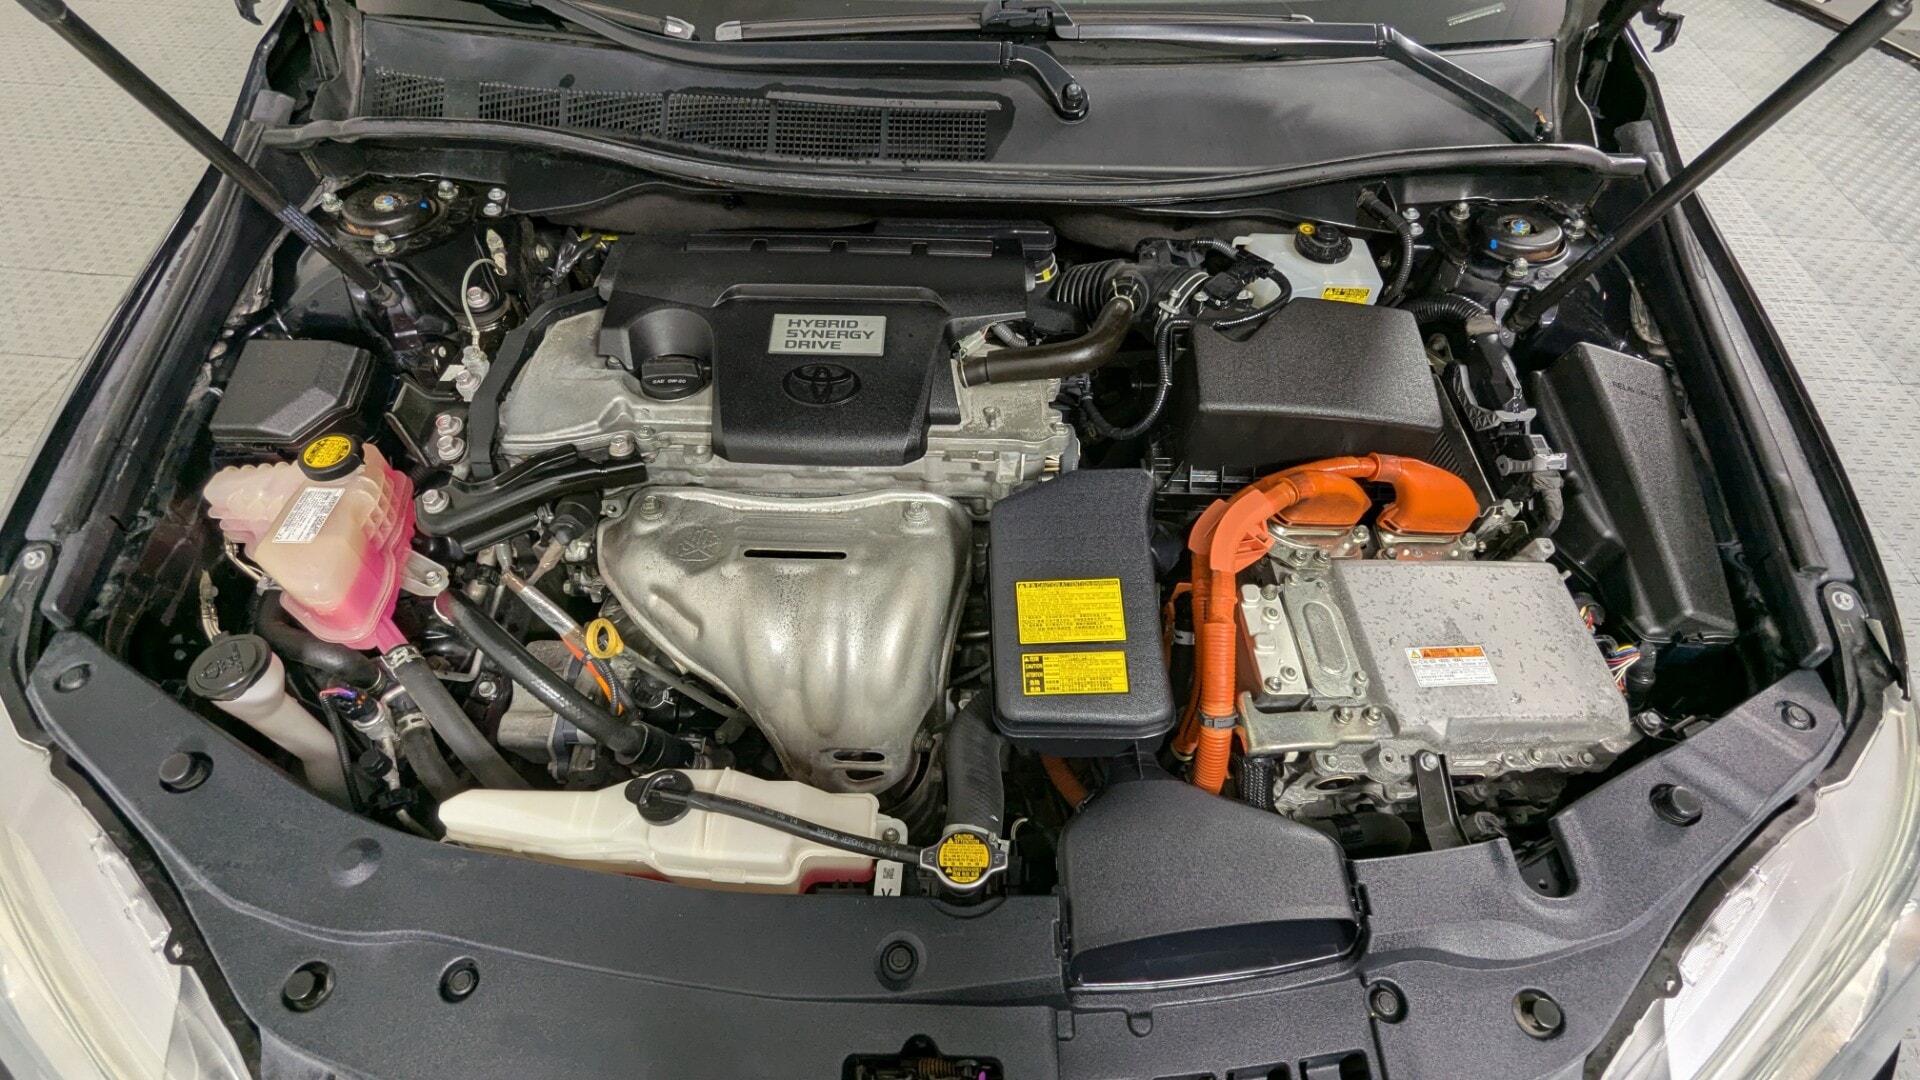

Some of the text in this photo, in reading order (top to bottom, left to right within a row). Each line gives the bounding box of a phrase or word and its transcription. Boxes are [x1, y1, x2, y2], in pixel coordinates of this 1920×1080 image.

[788, 319, 859, 329] HYBRID
[785, 329, 875, 339] SYNERGY
[784, 339, 842, 350] DRIVE
